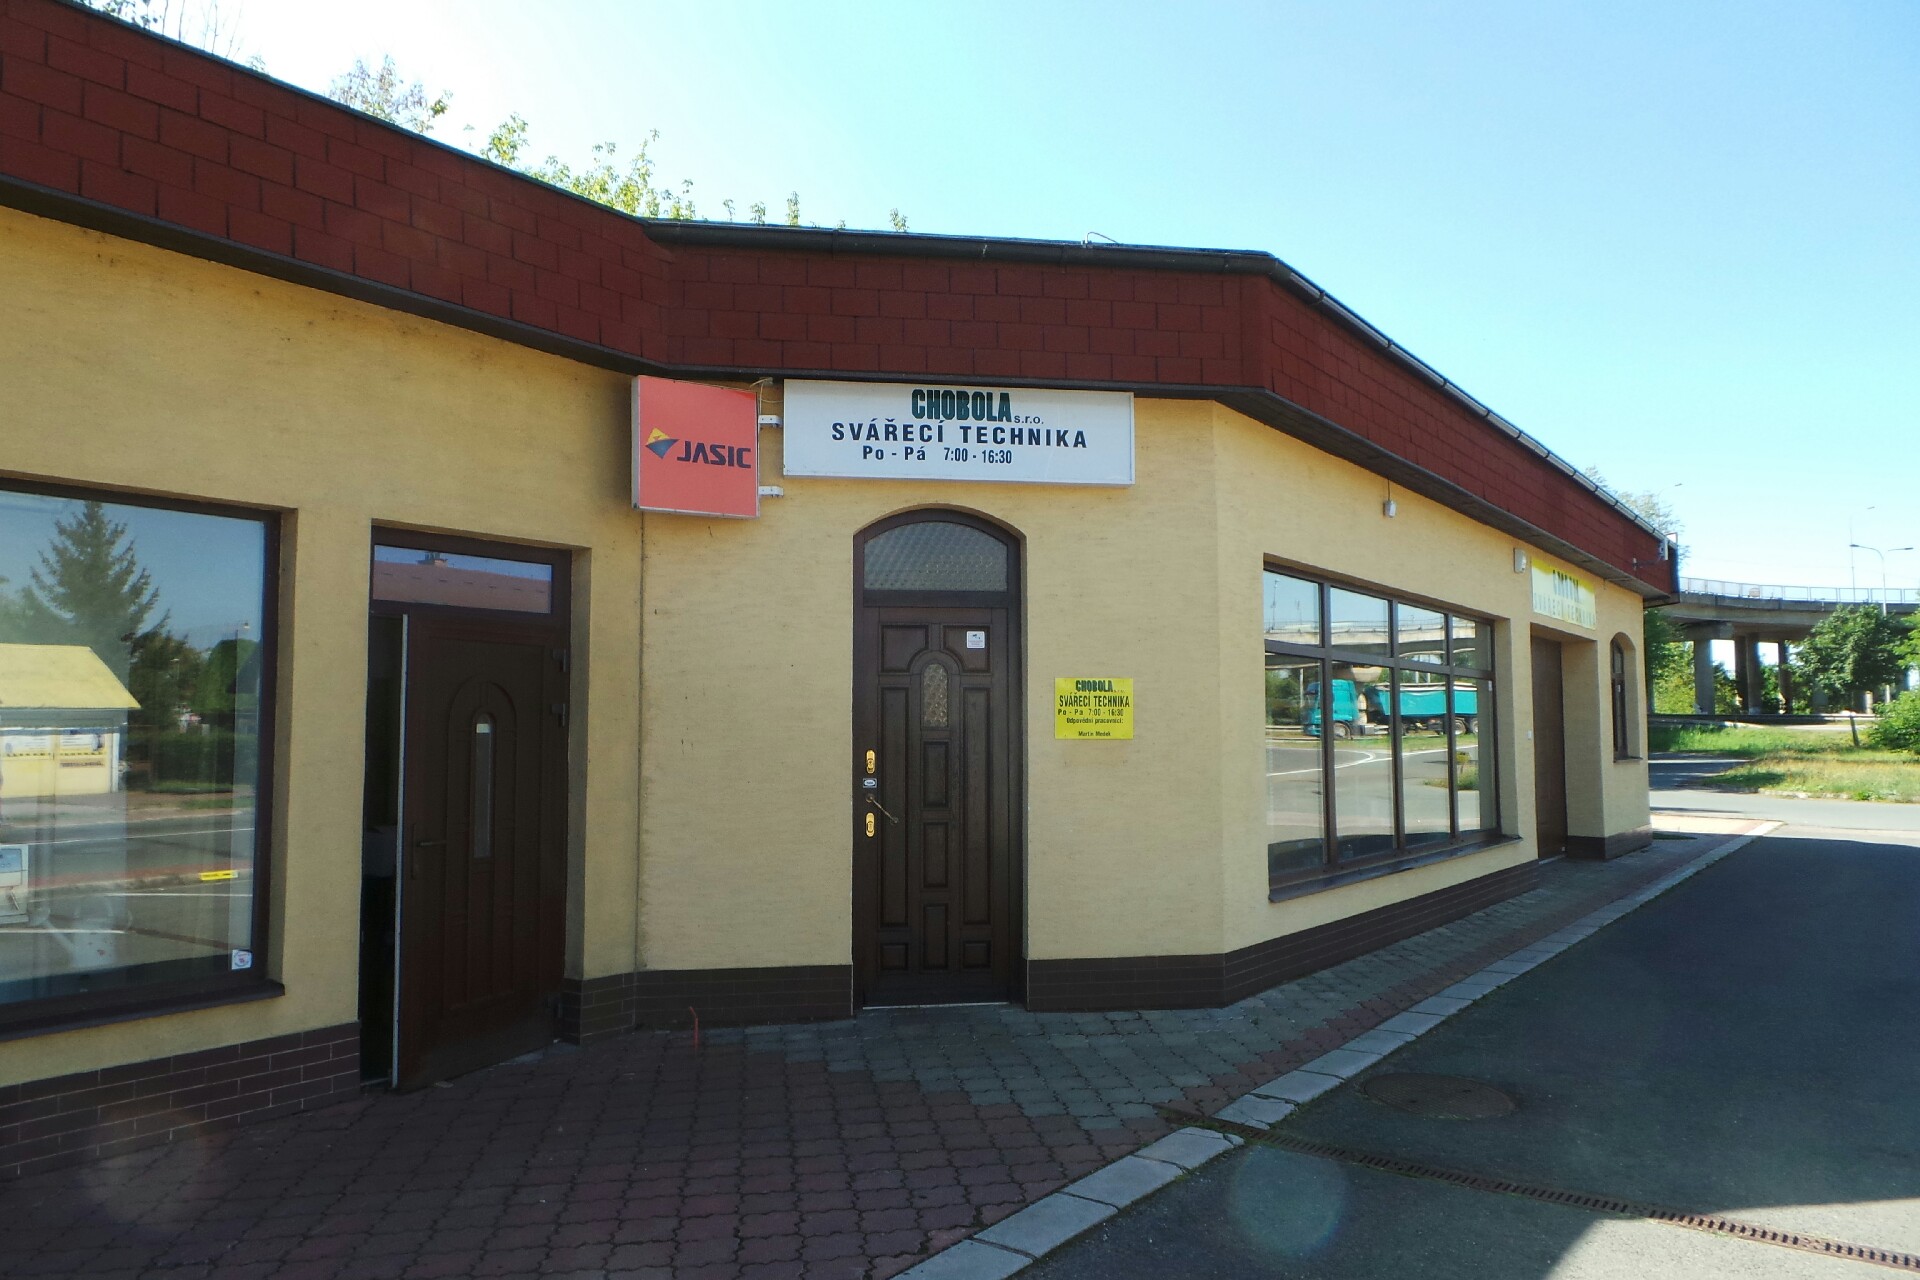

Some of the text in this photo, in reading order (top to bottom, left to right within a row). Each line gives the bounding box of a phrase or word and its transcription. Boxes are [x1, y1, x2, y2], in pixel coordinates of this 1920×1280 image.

[912, 389, 1044, 425] CHOBOLA s.r.o.
[832, 418, 1087, 449] SVÁŘECÍ TECHNIKA
[677, 440, 752, 469] JASIC
[862, 445, 884, 460] Po
[904, 446, 926, 461] Pá
[943, 447, 968, 462] 7:00
[981, 450, 1012, 464] 16:30
[1076, 680, 1113, 692] CHOBOLA
[1060, 692, 1130, 707] SVÁŘECÍ TECHNIKA
